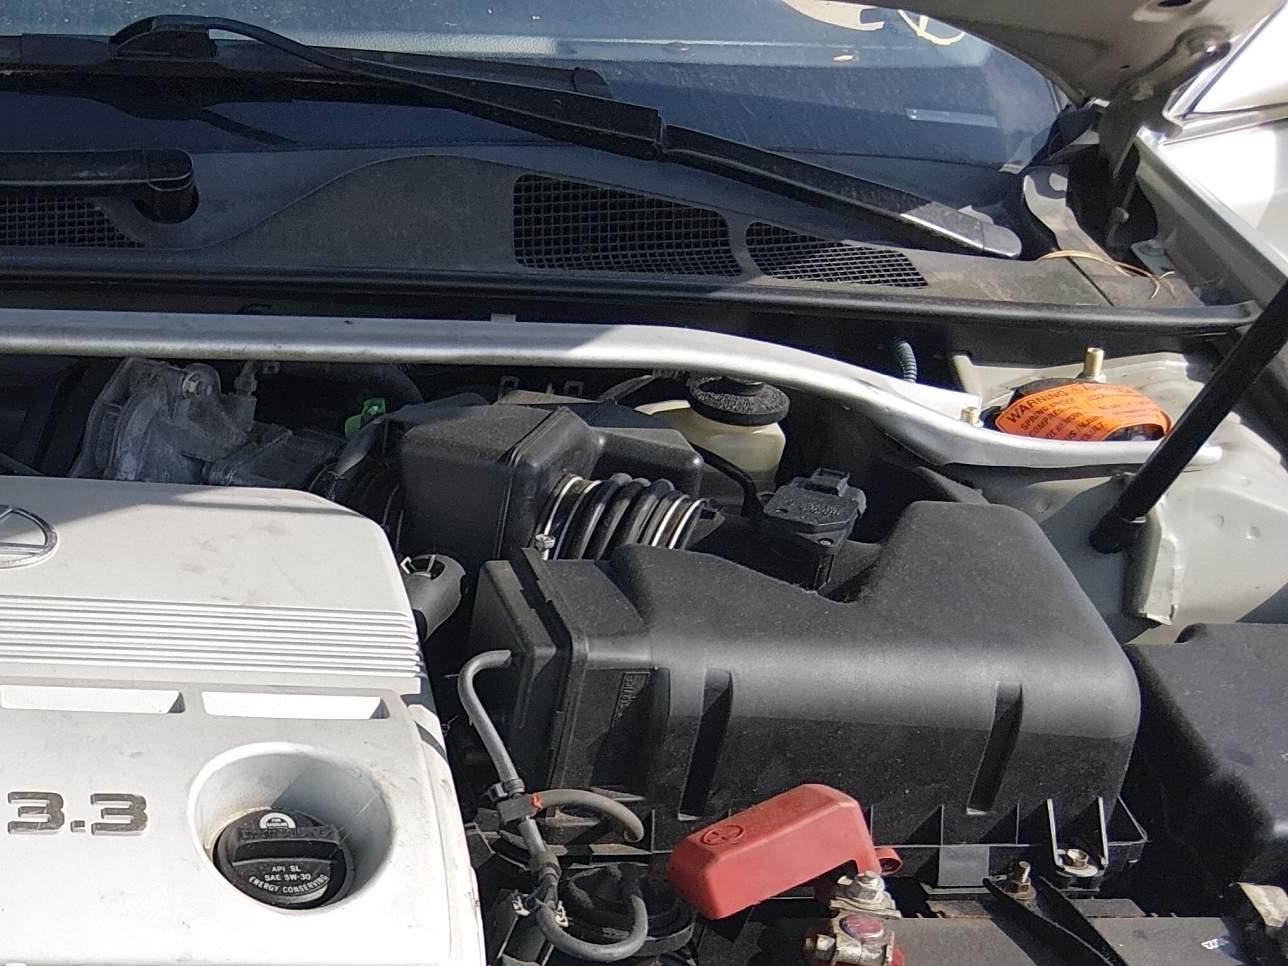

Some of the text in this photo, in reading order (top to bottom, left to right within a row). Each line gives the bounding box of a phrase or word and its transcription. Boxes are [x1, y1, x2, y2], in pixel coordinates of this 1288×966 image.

[1005, 390, 1070, 423] WARNING
[7, 791, 150, 838] 3.3
[248, 873, 331, 894] ENERGY CONSERVING
[284, 873, 312, 881] 5W-30
